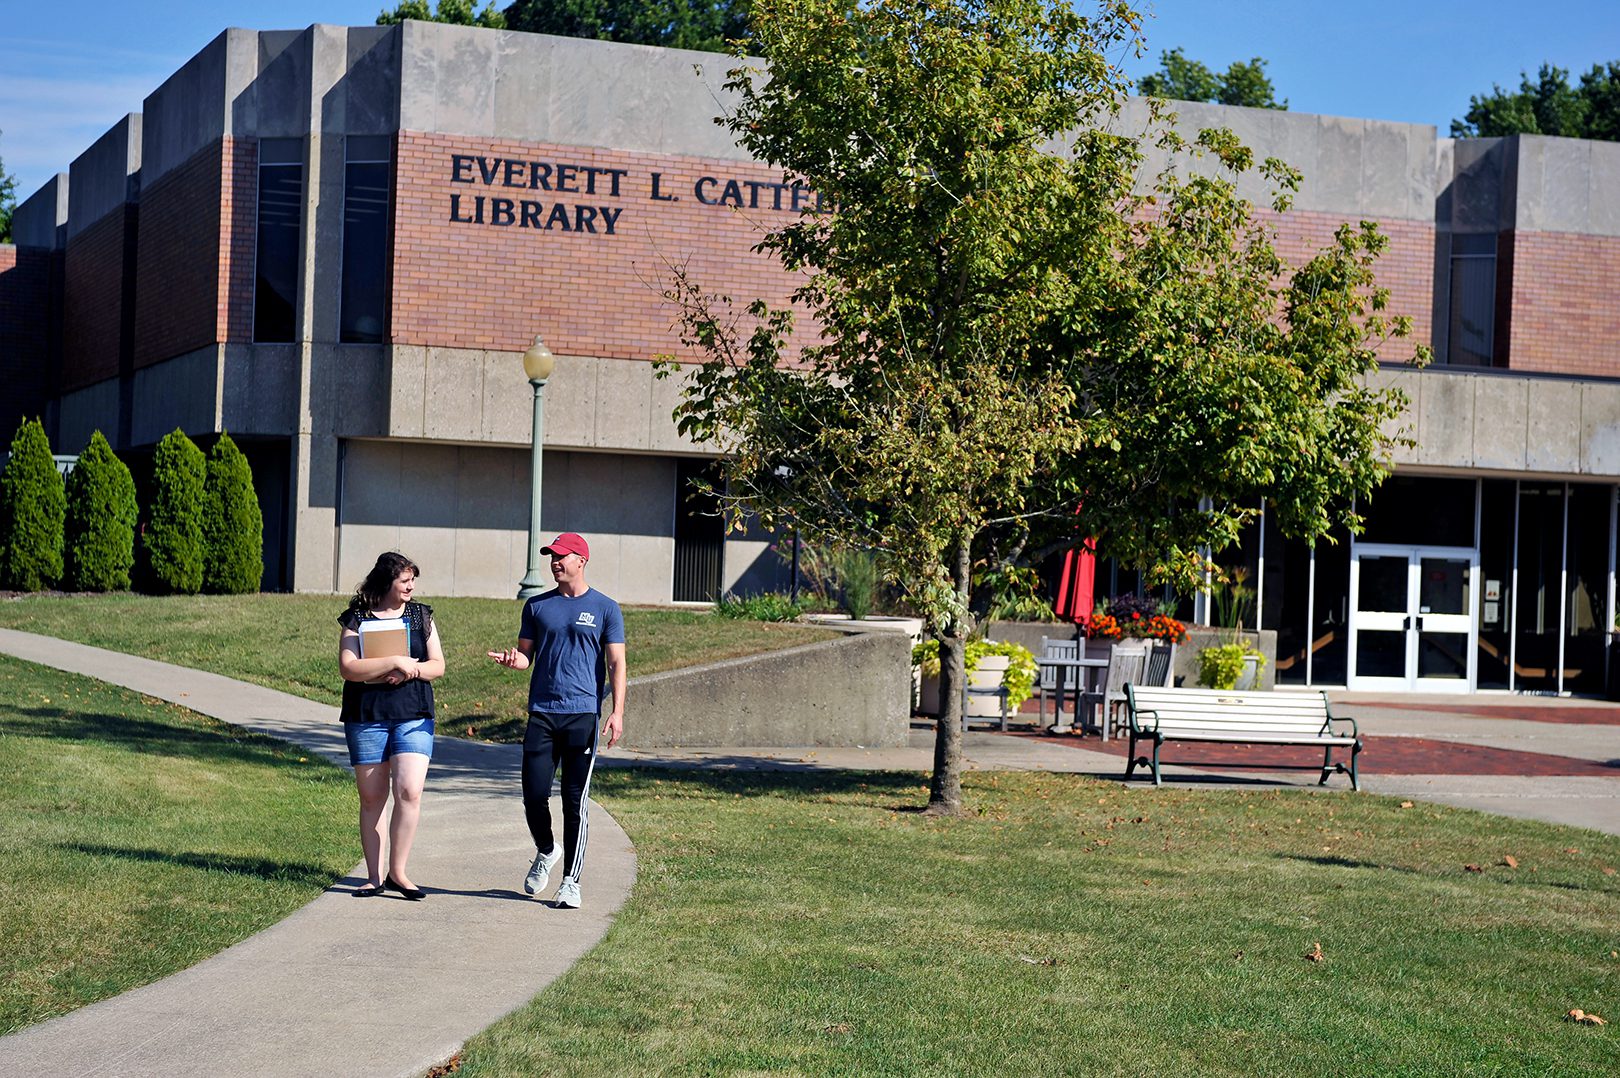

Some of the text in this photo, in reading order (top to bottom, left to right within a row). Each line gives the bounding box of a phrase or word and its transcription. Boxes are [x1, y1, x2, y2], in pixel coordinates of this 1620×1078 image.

[451, 154, 841, 215] EVERETT L. CATTEL
[449, 194, 623, 235] LIBRARY
